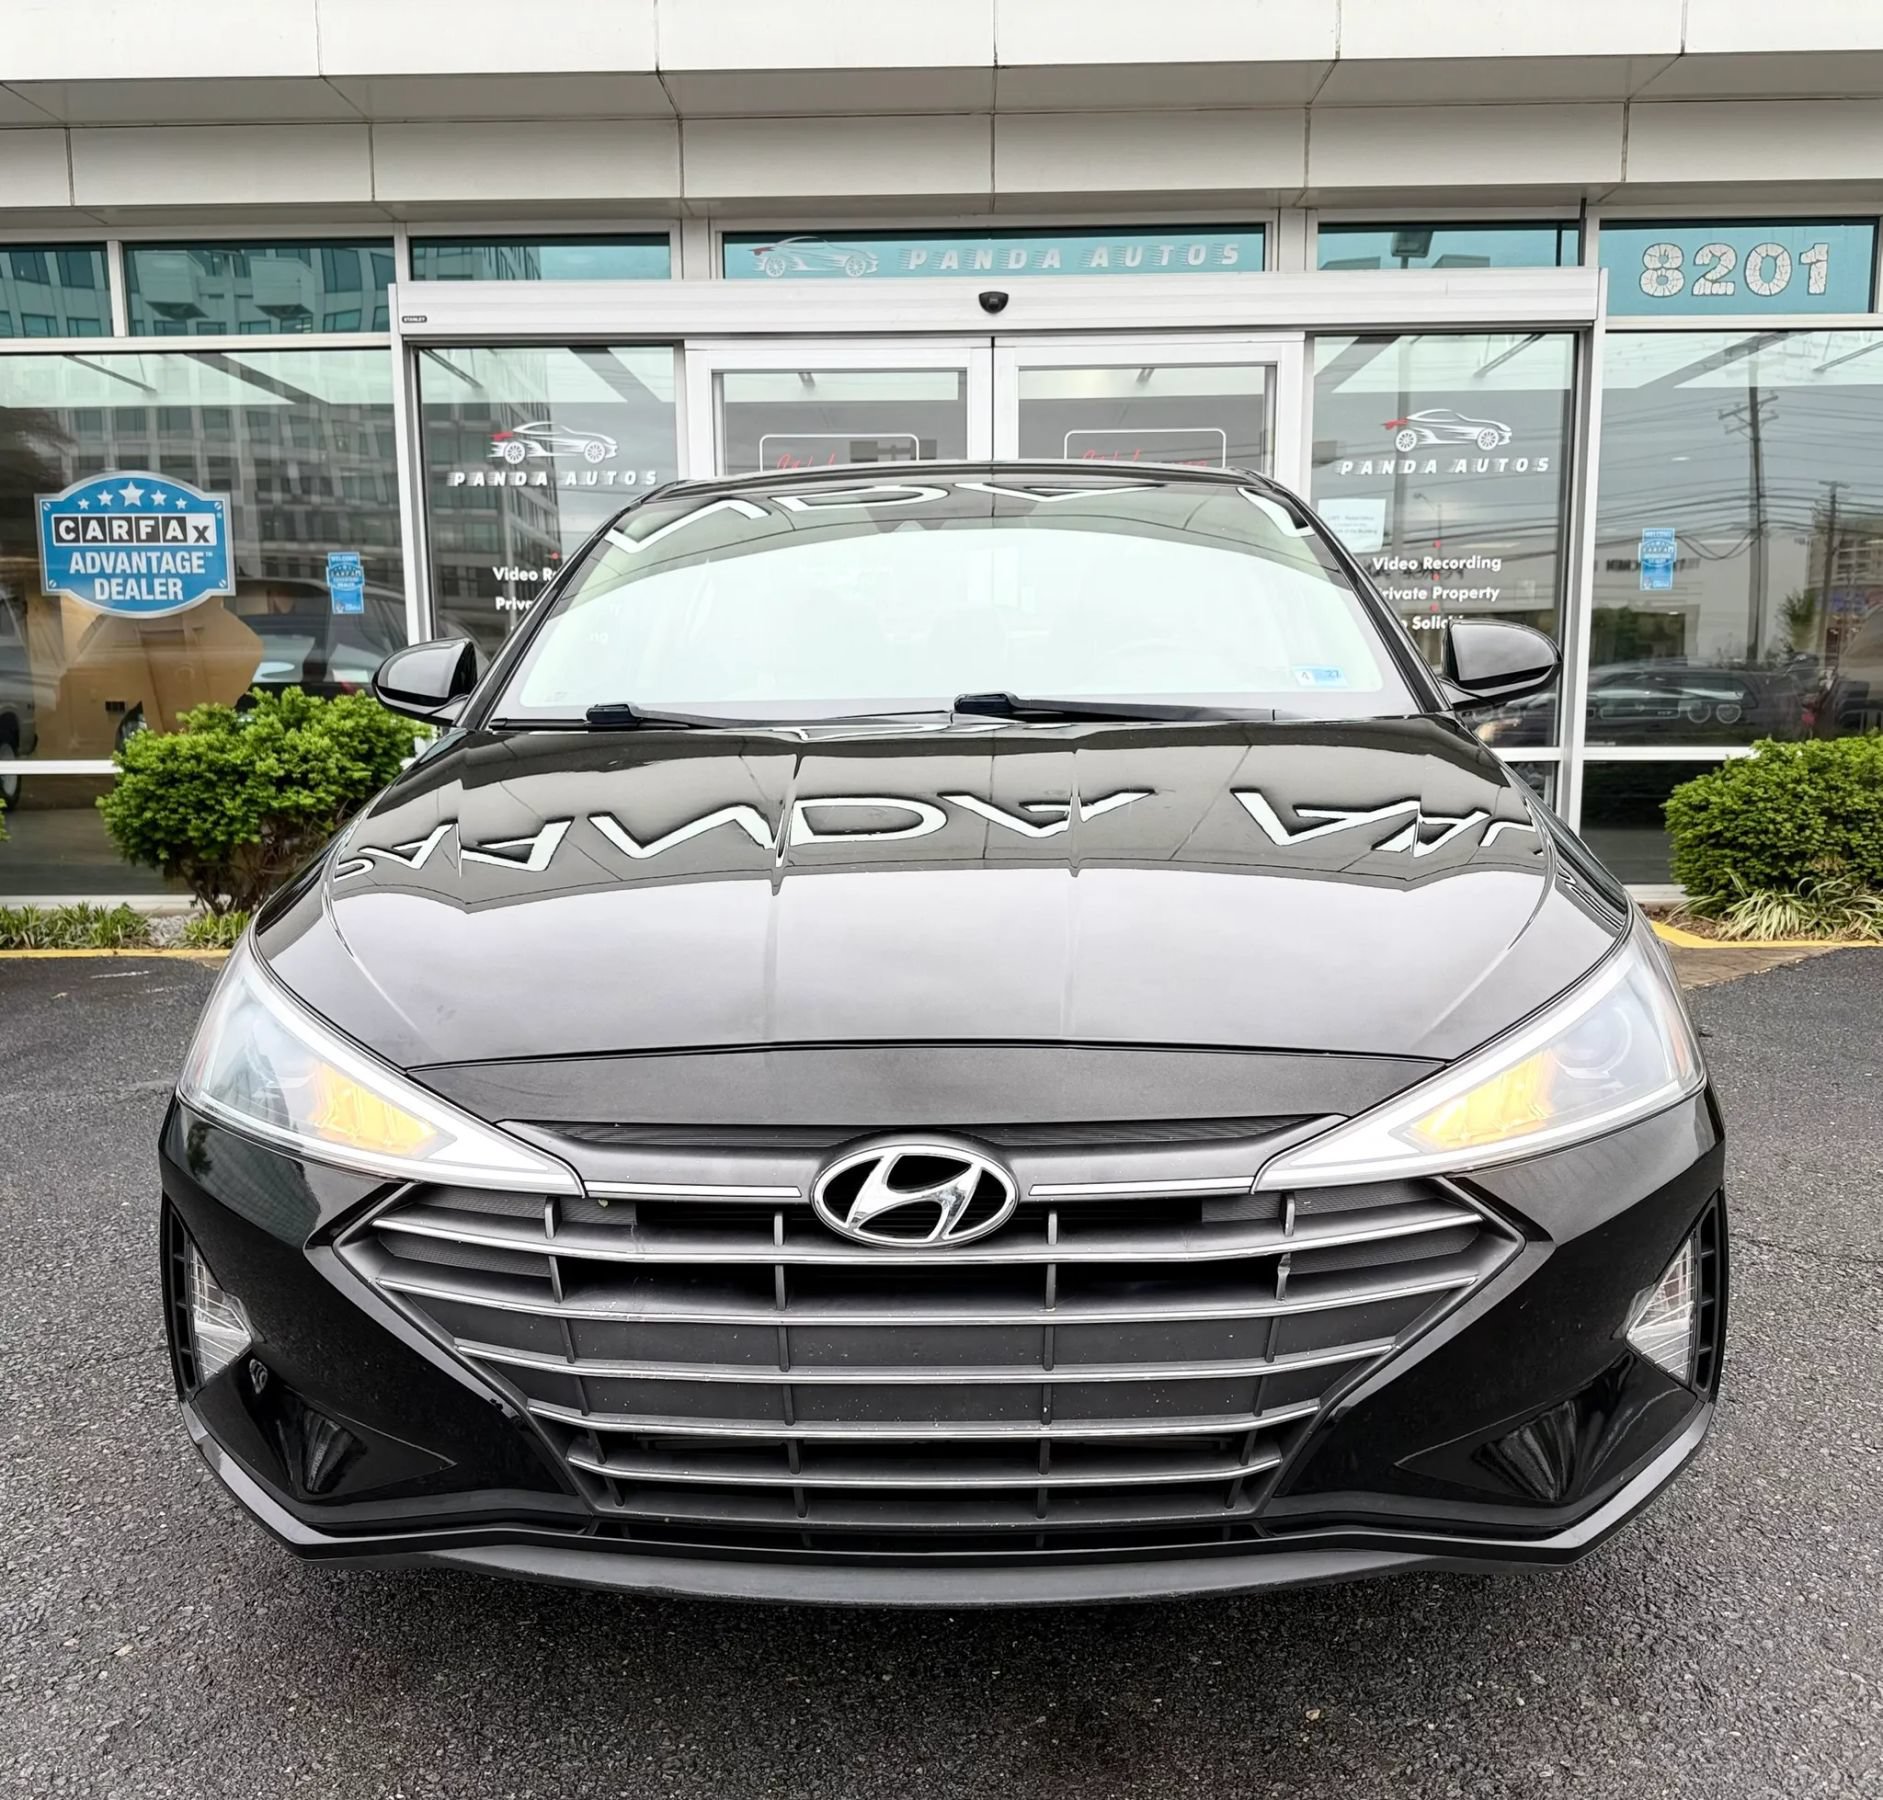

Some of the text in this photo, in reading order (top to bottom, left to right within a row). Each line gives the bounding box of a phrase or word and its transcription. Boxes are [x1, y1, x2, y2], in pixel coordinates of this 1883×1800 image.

[902, 243, 1240, 271] PANDA AUTOS
[1637, 242, 1830, 297] 8201
[1339, 457, 1550, 476] PANDA AUTOS
[452, 470, 658, 487] PANDA AUTOS
[57, 518, 211, 544] CARFAX
[1373, 555, 1418, 571] Video
[1423, 555, 1502, 573] Recording
[492, 566, 538, 582] Video
[94, 577, 184, 601] DEALER
[1379, 586, 1500, 603] rivate Property
